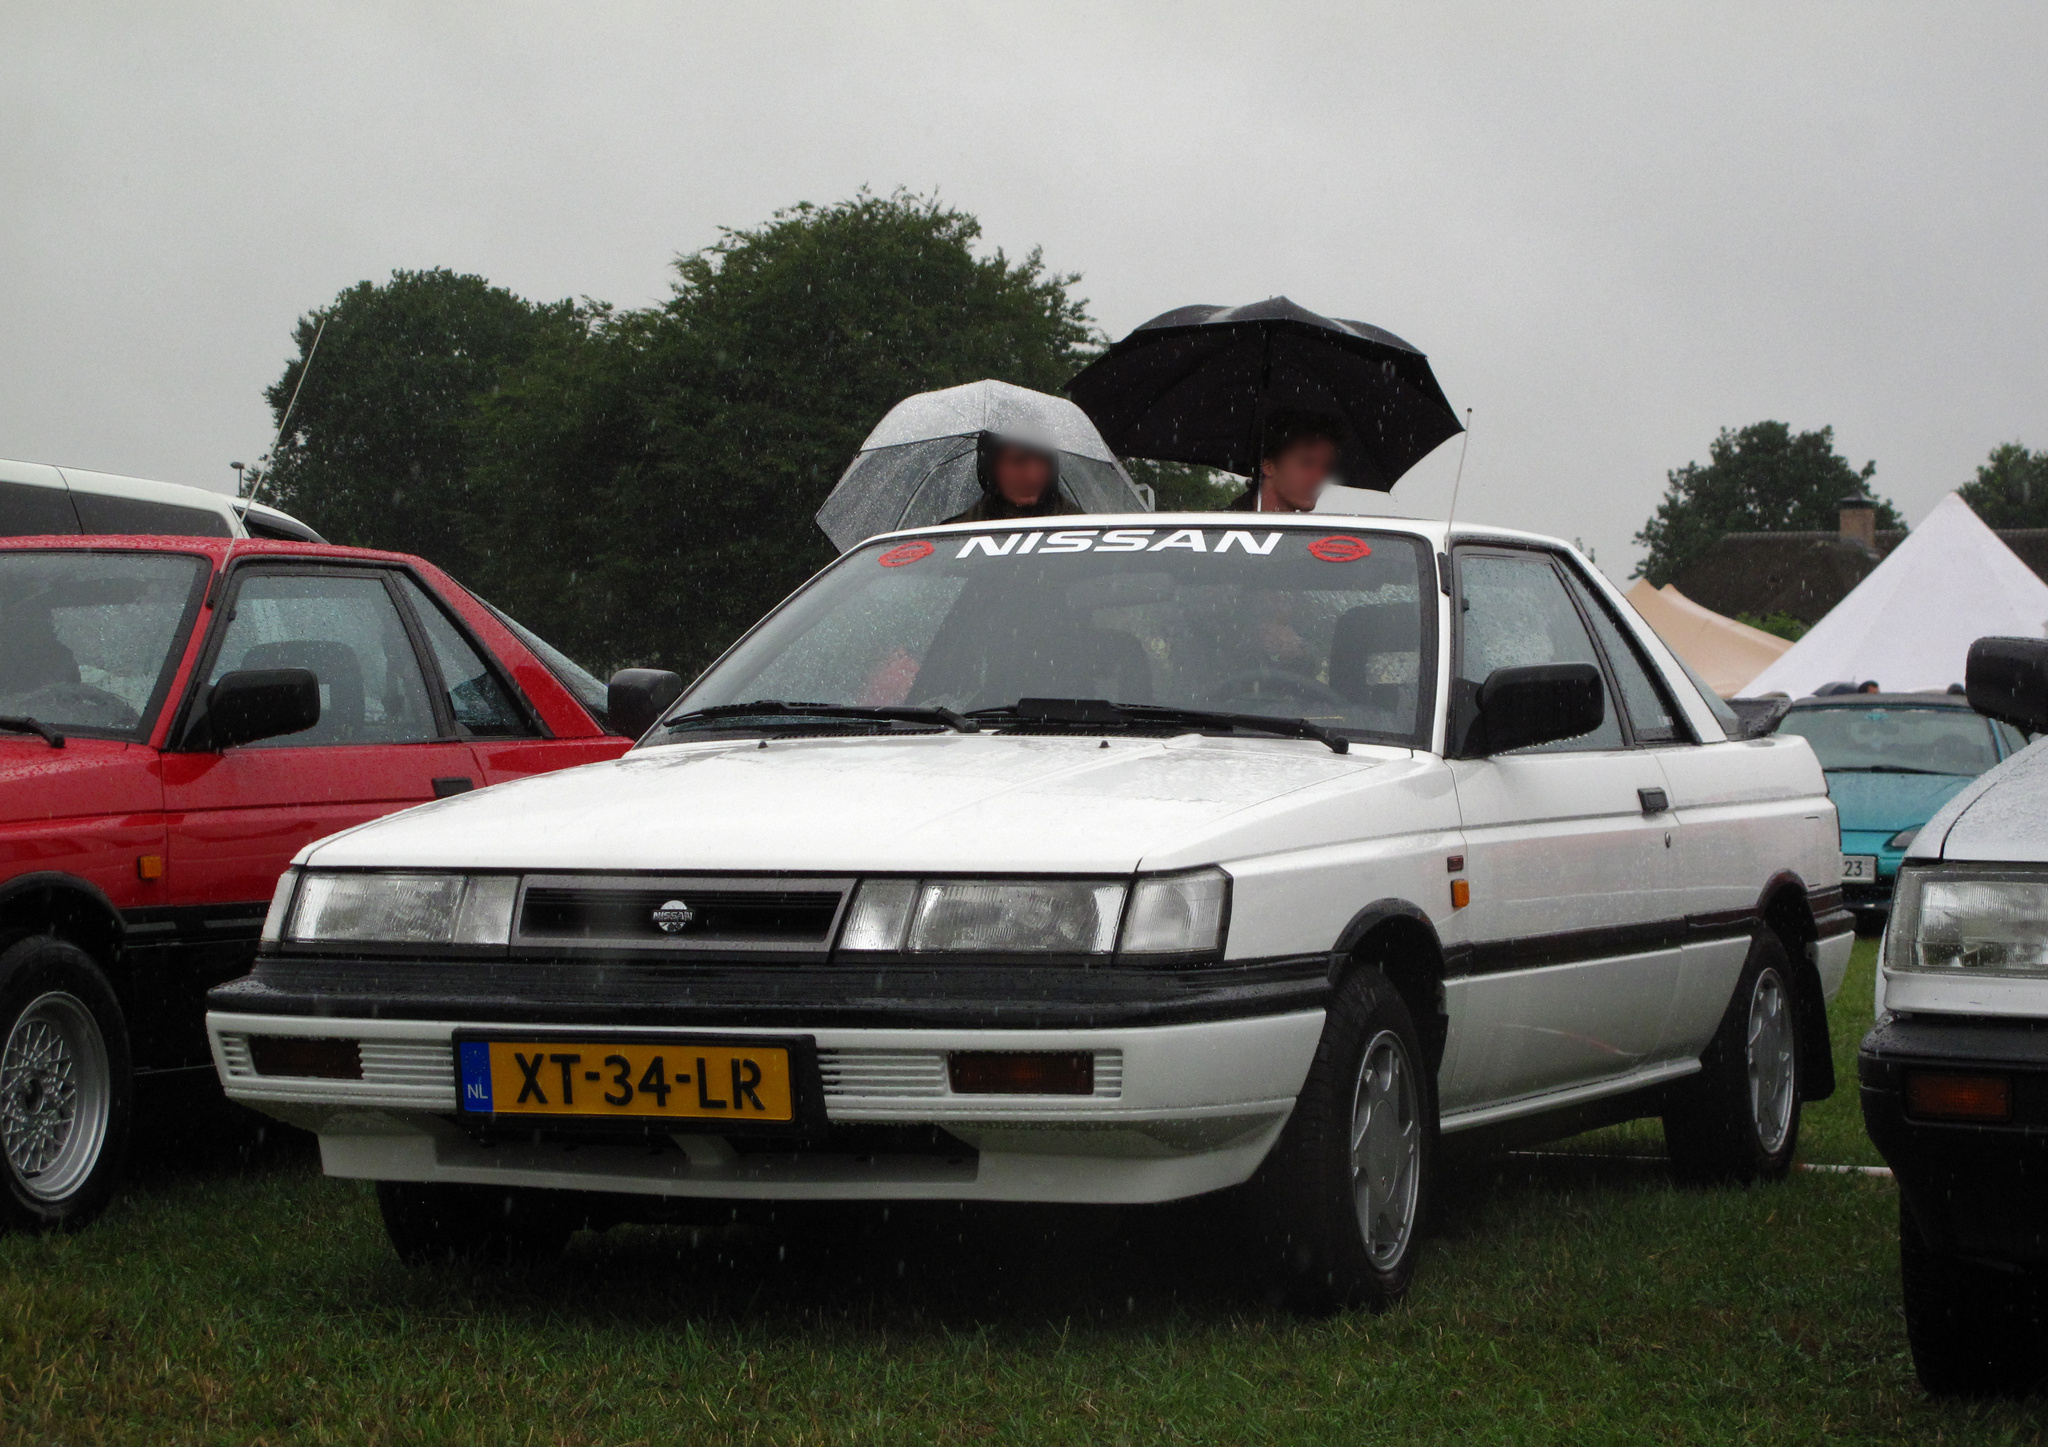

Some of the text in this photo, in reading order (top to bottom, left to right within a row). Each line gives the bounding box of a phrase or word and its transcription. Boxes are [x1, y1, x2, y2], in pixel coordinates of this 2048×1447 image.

[955, 529, 1283, 559] NISSAN
[1844, 860, 1863, 877] 23
[652, 911, 693, 921] NISSAN
[514, 1052, 766, 1111] XT-34-LR
[467, 1083, 488, 1100] NL
